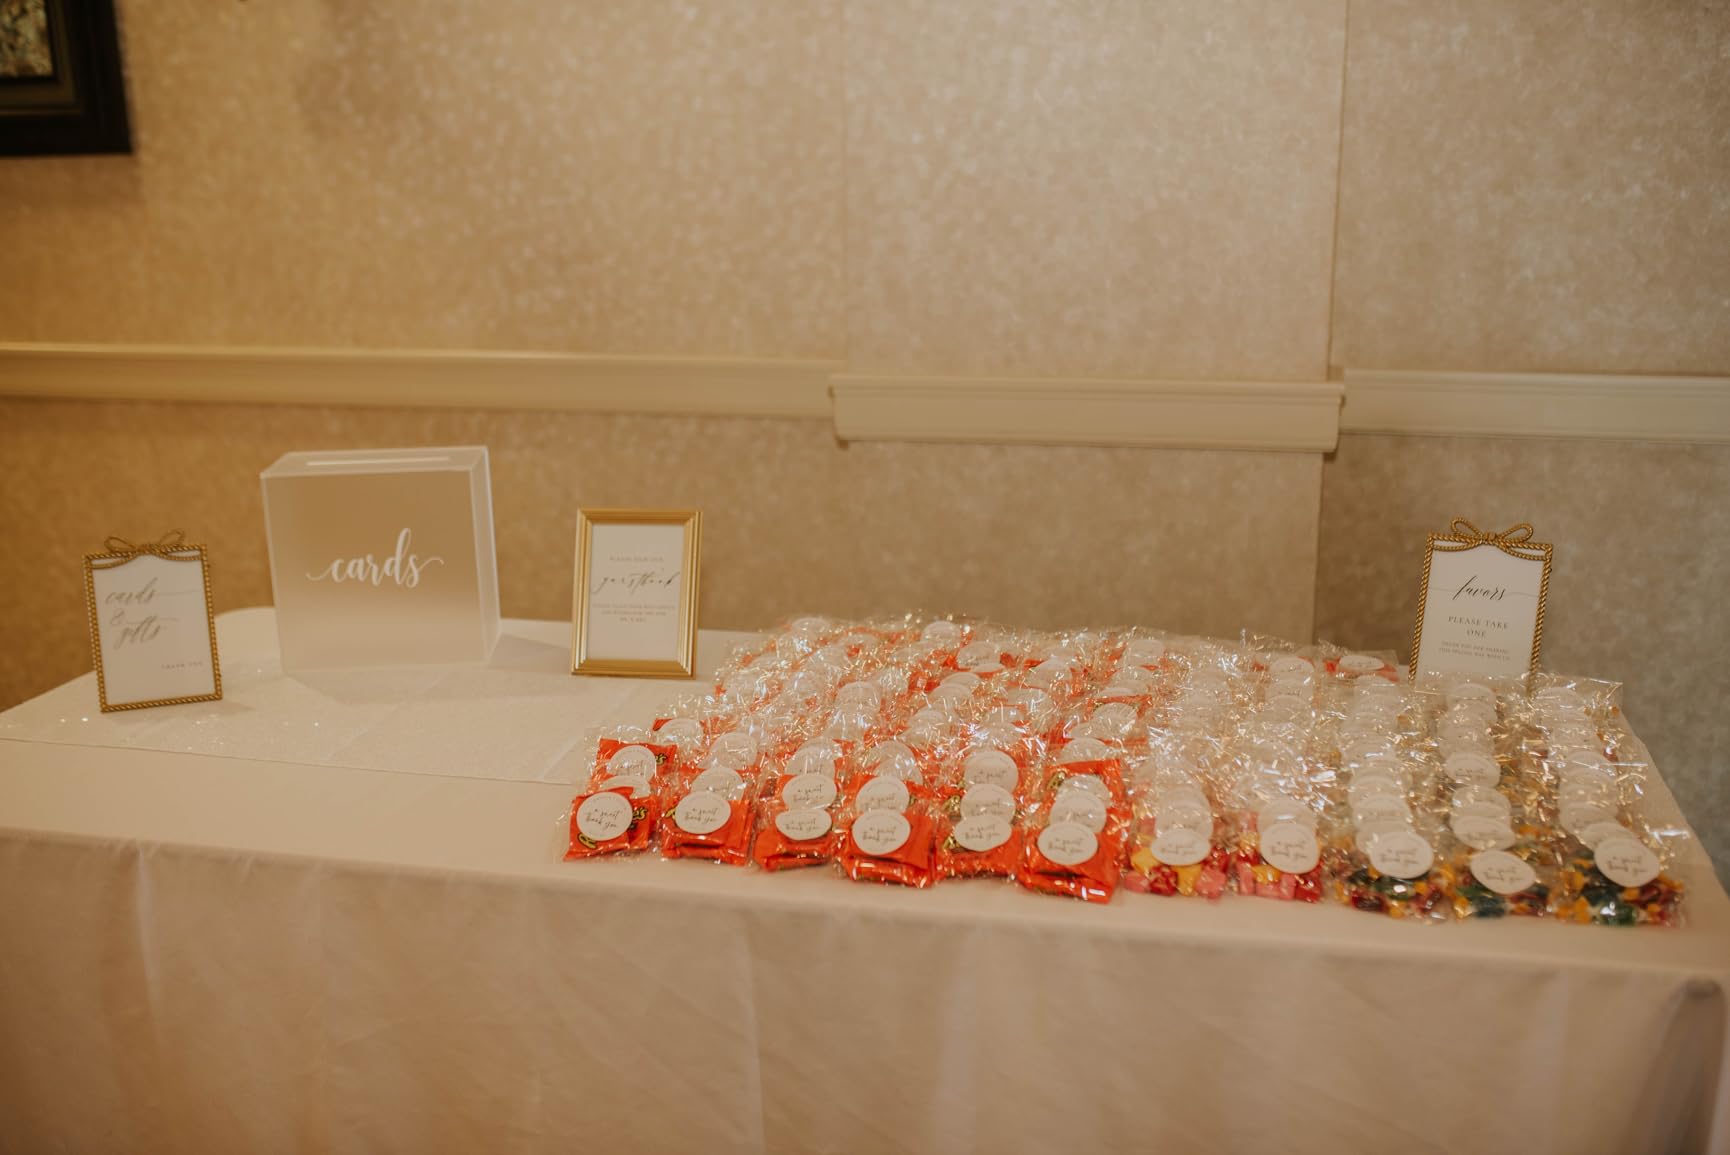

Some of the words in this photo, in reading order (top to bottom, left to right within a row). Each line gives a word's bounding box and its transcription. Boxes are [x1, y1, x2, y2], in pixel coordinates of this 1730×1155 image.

[306, 527, 445, 588] cards
[1451, 575, 1507, 601] favors
[1448, 616, 1480, 626] PLEASE
[1485, 620, 1509, 629] TAKE
[1466, 629, 1486, 638] ONE
